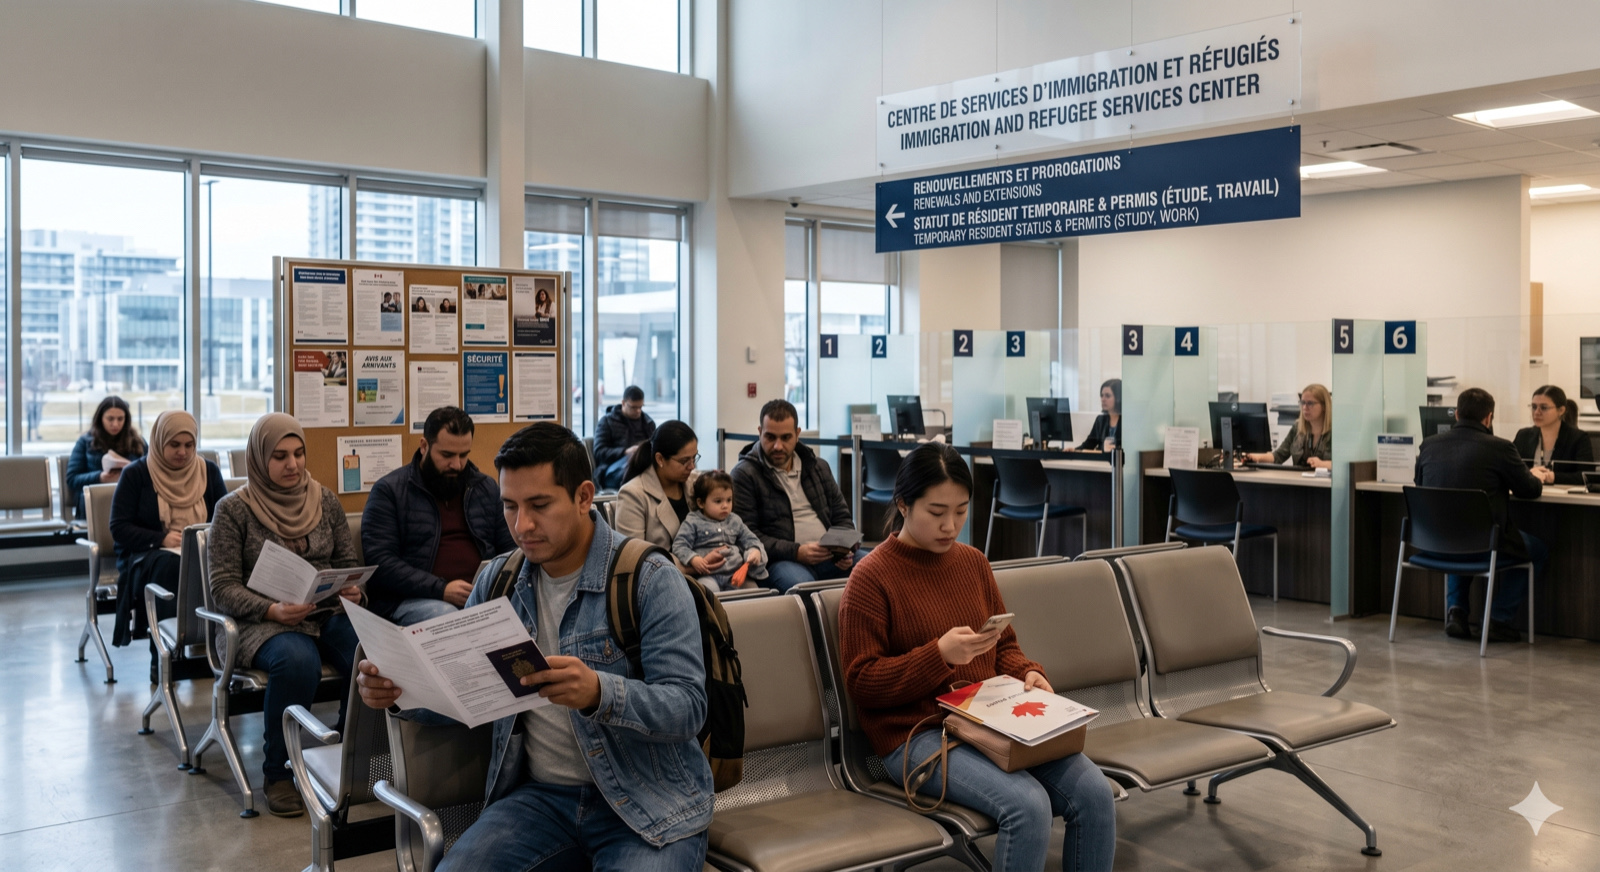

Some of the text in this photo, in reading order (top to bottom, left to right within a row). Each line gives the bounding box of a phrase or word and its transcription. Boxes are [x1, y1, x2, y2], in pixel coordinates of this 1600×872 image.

[888, 103, 936, 128] CENTRE
[940, 99, 957, 119] DE
[961, 86, 1028, 115] SERVICES
[1164, 56, 1184, 80] ET
[1189, 35, 1280, 75] RÉFUGIÉS
[901, 73, 1260, 150] IMMIGRATION AND REFUGEE SERVICES CENTER
[914, 155, 1121, 195] RENOUVELLEMENTS ET PROROGATIONS
[914, 183, 1042, 211] RENEWALS AND EXTENSIONS
[914, 177, 1279, 231] STATUT DE RÉSIDENT TEMPORAIRE & PERMIS (ÉTUDE, TRAVAIL)
[914, 206, 1199, 245] TEMPORARY RESIDENT STATUS & PERMITS (STUDY, WORK)
[825, 338, 832, 355] 1
[875, 339, 883, 354] 2
[959, 334, 968, 352] 2
[1011, 335, 1020, 352] 3
[1129, 330, 1138, 350] 3
[1181, 331, 1192, 351] 4
[1340, 325, 1349, 348] 5
[1392, 326, 1408, 349] 6
[467, 354, 503, 363] SÉCURITÉ
